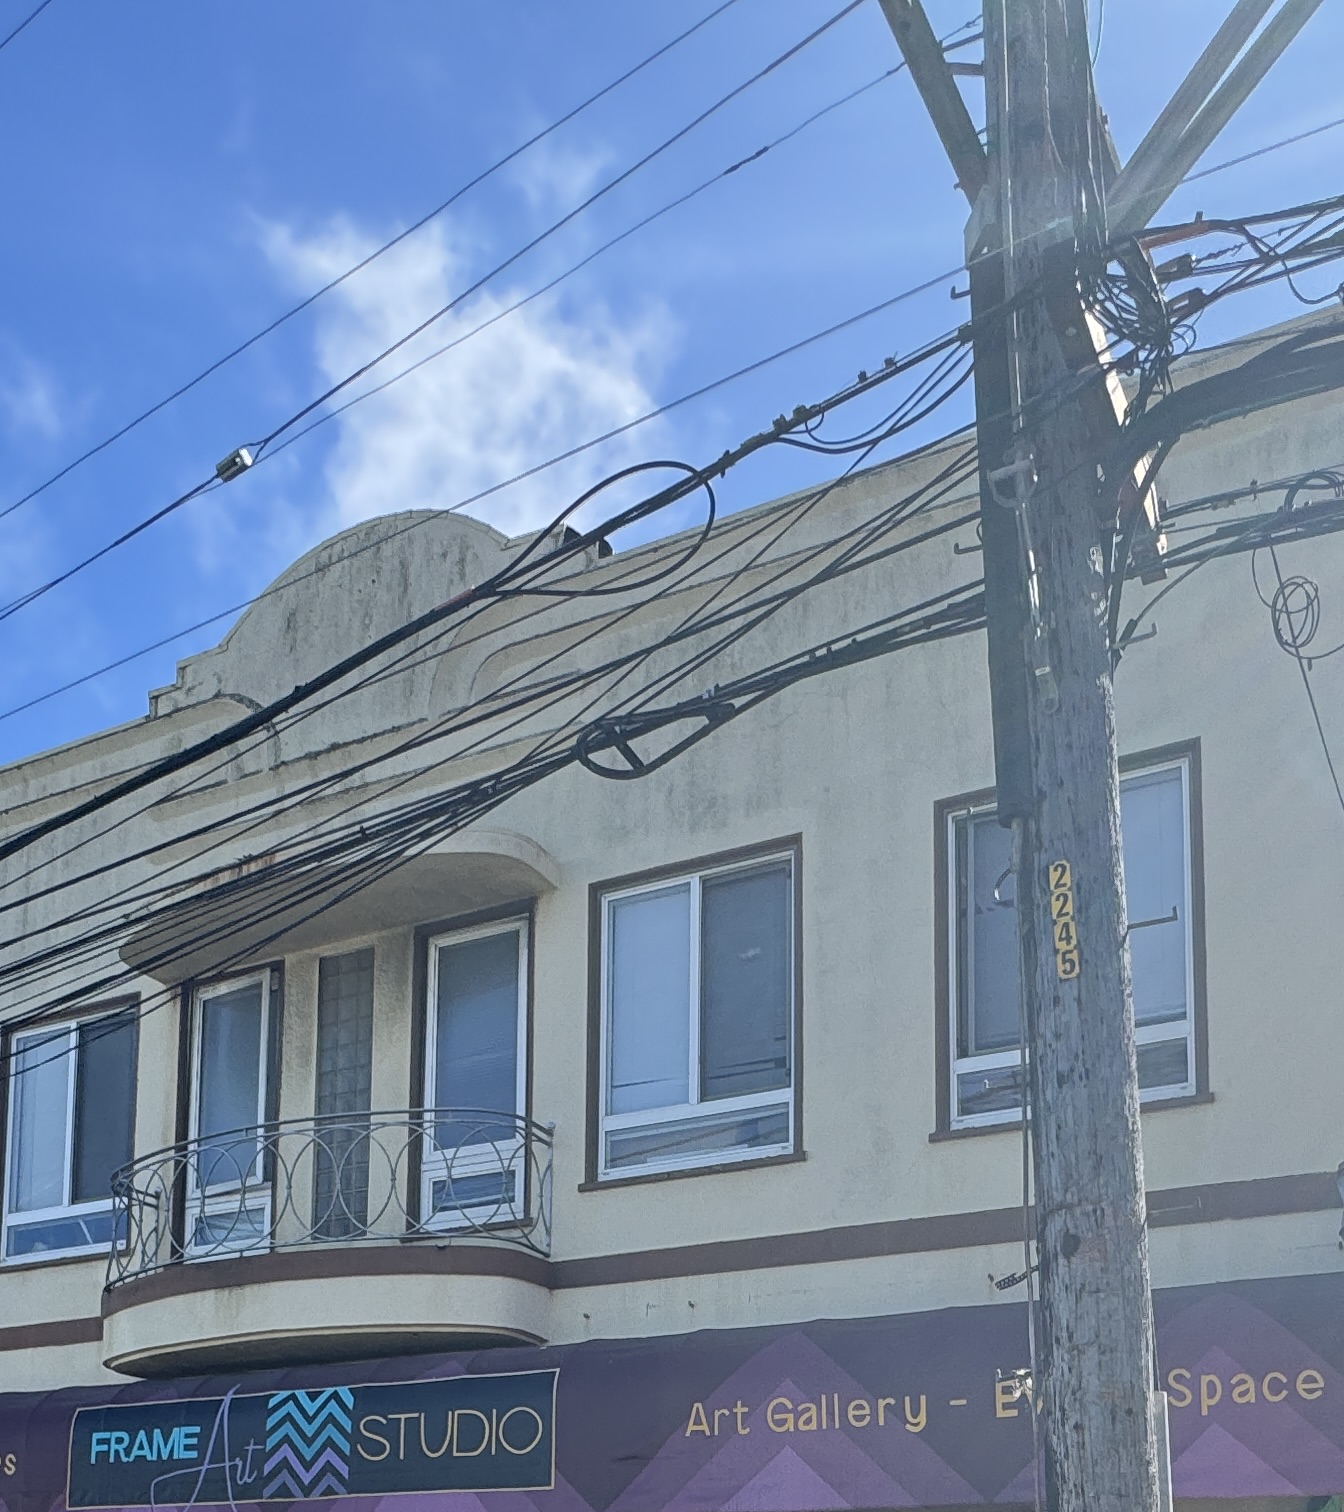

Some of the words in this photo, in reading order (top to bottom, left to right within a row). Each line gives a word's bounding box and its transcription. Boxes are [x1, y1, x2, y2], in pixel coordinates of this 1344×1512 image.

[1052, 863, 1076, 976] 2245
[685, 1400, 750, 1437] Art
[767, 1393, 927, 1433] Gallery
[1168, 1367, 1325, 1416] Space
[90, 1426, 201, 1465] FRAME
[357, 1406, 543, 1461] STUDIO
